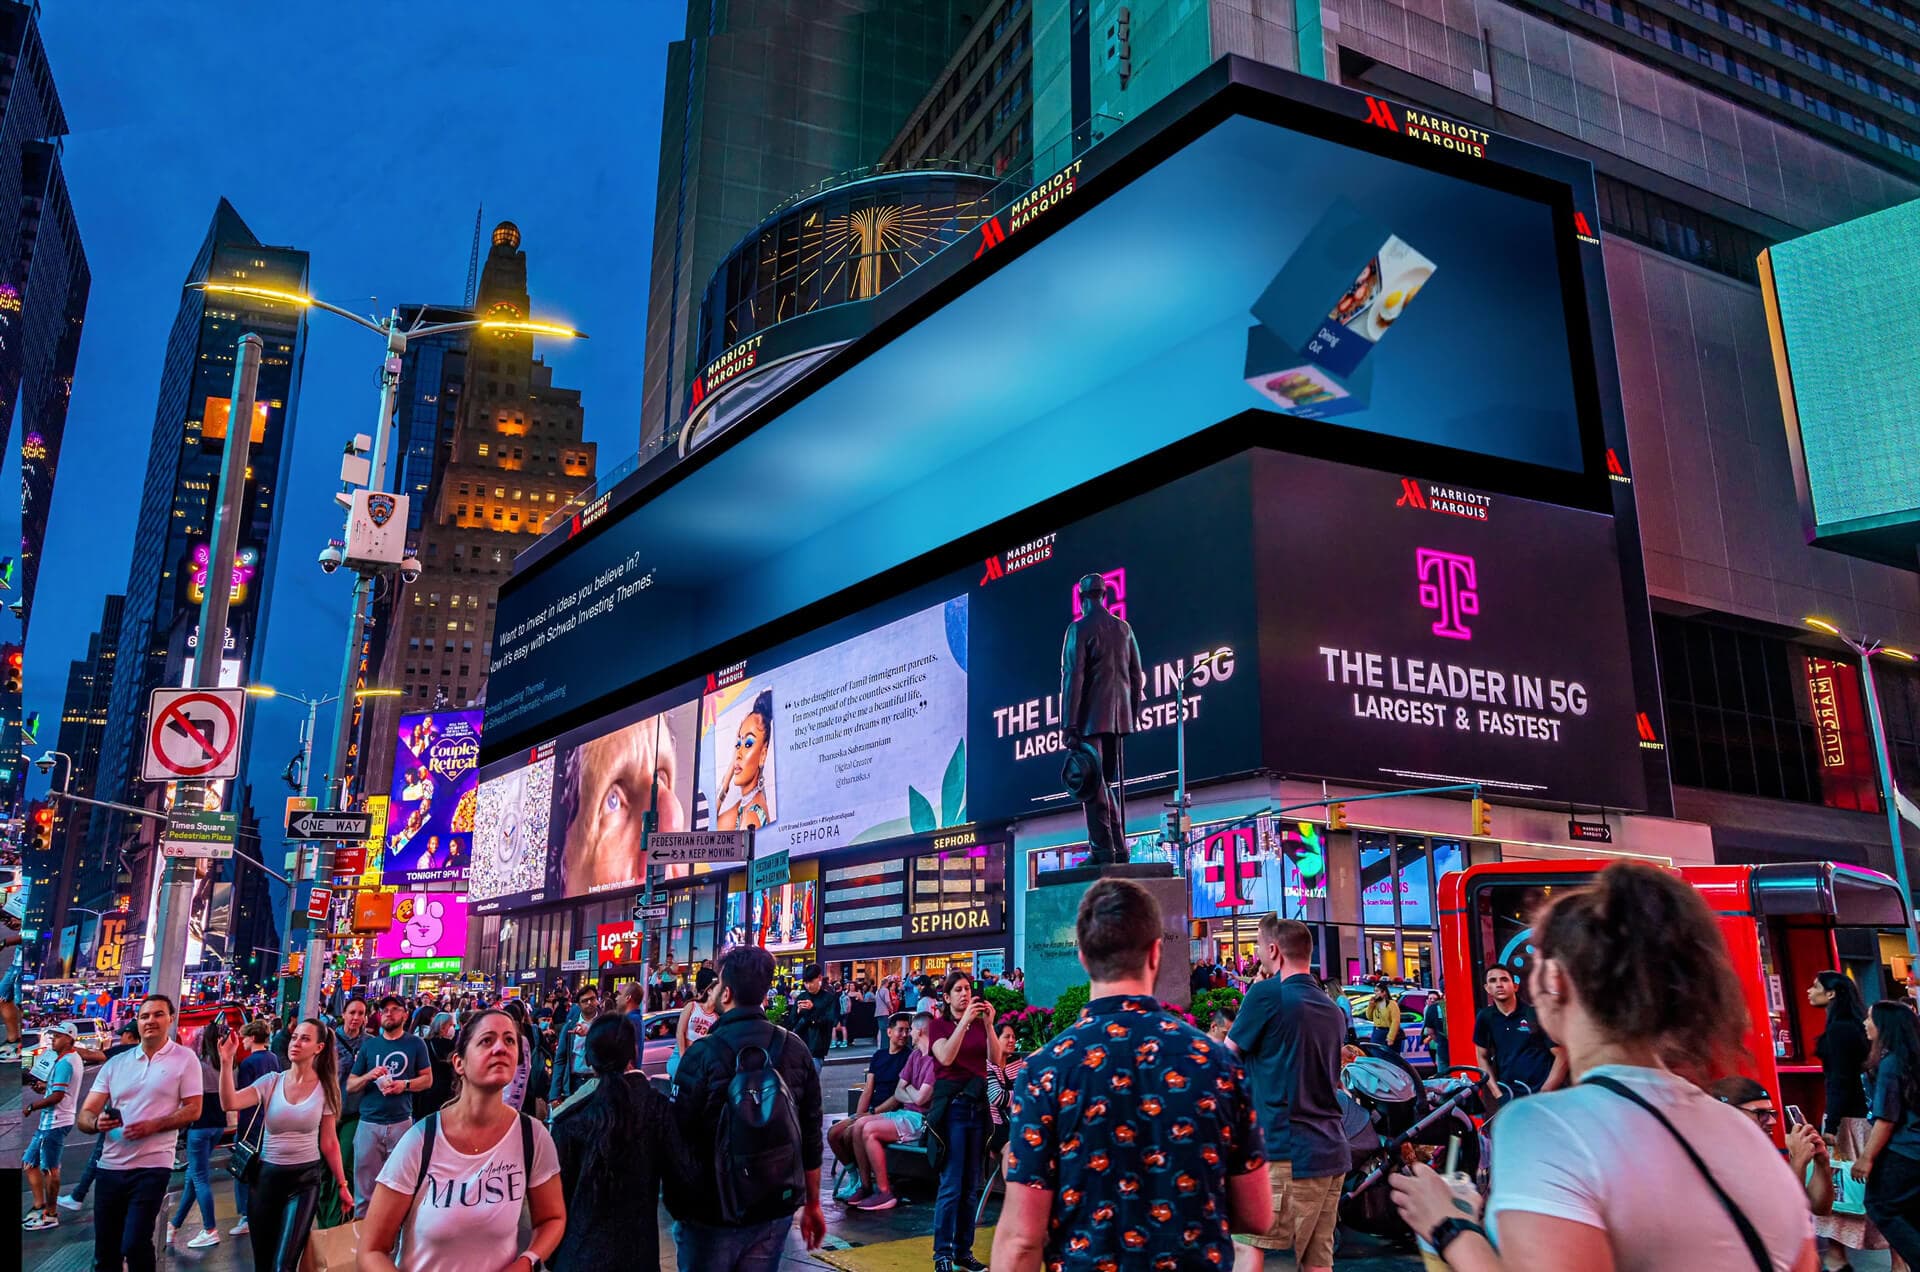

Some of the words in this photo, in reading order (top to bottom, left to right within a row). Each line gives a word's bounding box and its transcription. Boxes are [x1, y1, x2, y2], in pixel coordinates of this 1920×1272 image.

[1406, 110, 1490, 145] MARRIOTT
[1407, 127, 1485, 159] MARQUIS
[1010, 159, 1083, 214] MARRIOTT
[1010, 180, 1075, 231] MARQUIS
[1308, 340, 1323, 354] Out
[1318, 327, 1341, 348] Dining
[707, 335, 763, 376] MARRIOTT
[706, 353, 756, 393] MARQUIS
[584, 491, 612, 518] MARRIOTT
[1430, 486, 1492, 507] MARRIOTT
[583, 504, 608, 528] MARQUIS
[1432, 499, 1487, 519] MARQUIS
[1006, 533, 1058, 560] MARRIOTT
[1006, 546, 1052, 573] MARQUIS
[499, 629, 517, 647] Want
[518, 625, 525, 637] to
[526, 610, 547, 632] invest
[547, 604, 555, 619] in
[556, 592, 577, 614] ideas
[577, 583, 592, 605] you
[594, 567, 624, 591] believe
[625, 551, 640, 572] in?
[503, 650, 512, 667] it's
[513, 642, 529, 660] easy
[530, 631, 545, 650] with
[546, 615, 576, 642] Schwab
[578, 594, 615, 625] Investing
[718, 671, 743, 687] MARQUIS
[719, 660, 747, 677] MARRIOTT
[801, 696, 811, 706] the
[811, 687, 840, 703] daughter
[840, 683, 849, 693] of
[849, 675, 868, 690] Tamil
[868, 664, 907, 684] immigrant
[993, 699, 1040, 738] THE
[1154, 658, 1185, 698] IN
[1192, 646, 1235, 687] 5G
[1319, 647, 1383, 688] THE
[1391, 658, 1506, 705] LEADER
[1513, 675, 1544, 709] IN
[1550, 681, 1588, 716] 5G
[802, 708, 819, 720] most
[819, 700, 839, 718] proud
[839, 697, 848, 708] of
[848, 694, 858, 706] the
[858, 683, 892, 704] countless
[892, 672, 927, 692] sacrifices
[794, 722, 816, 738] they've
[816, 717, 835, 732] made
[835, 715, 842, 724] to
[842, 709, 856, 723] give
[857, 706, 868, 717] me
[868, 705, 874, 714] a
[874, 692, 907, 711] beautiful
[1354, 693, 1446, 727] LARGEST
[1455, 708, 1470, 732] &
[1478, 711, 1560, 742] FASTEST
[789, 738, 808, 752] where
[812, 734, 824, 746] can
[824, 728, 842, 743] make
[842, 726, 854, 738] my
[854, 718, 880, 732] dreams
[881, 715, 893, 728] my
[430, 742, 480, 760] Couples
[429, 755, 477, 773] Retreat
[834, 760, 852, 774] Digital
[852, 757, 873, 769] Creator
[169, 831, 211, 840] Pedestrian
[211, 833, 232, 841] Plaza
[171, 821, 195, 830] Times
[196, 822, 225, 832] Square
[301, 820, 324, 831] ONE
[336, 820, 361, 832] WAY
[791, 824, 840, 845] SEPHORA
[651, 836, 695, 847] PEDESTRIAN
[696, 835, 715, 845] FLOW
[717, 834, 736, 845] ZONE
[934, 833, 976, 849] SEPHORA
[688, 849, 707, 859] KEEP
[708, 847, 735, 858] MOVING
[406, 871, 443, 881] TONIGHT
[443, 870, 459, 878] 9PM
[911, 910, 990, 934] SEPHORA
[695, 1025, 707, 1036] 23
[478, 1159, 518, 1178] Modern
[423, 1171, 522, 1208] MUSE
